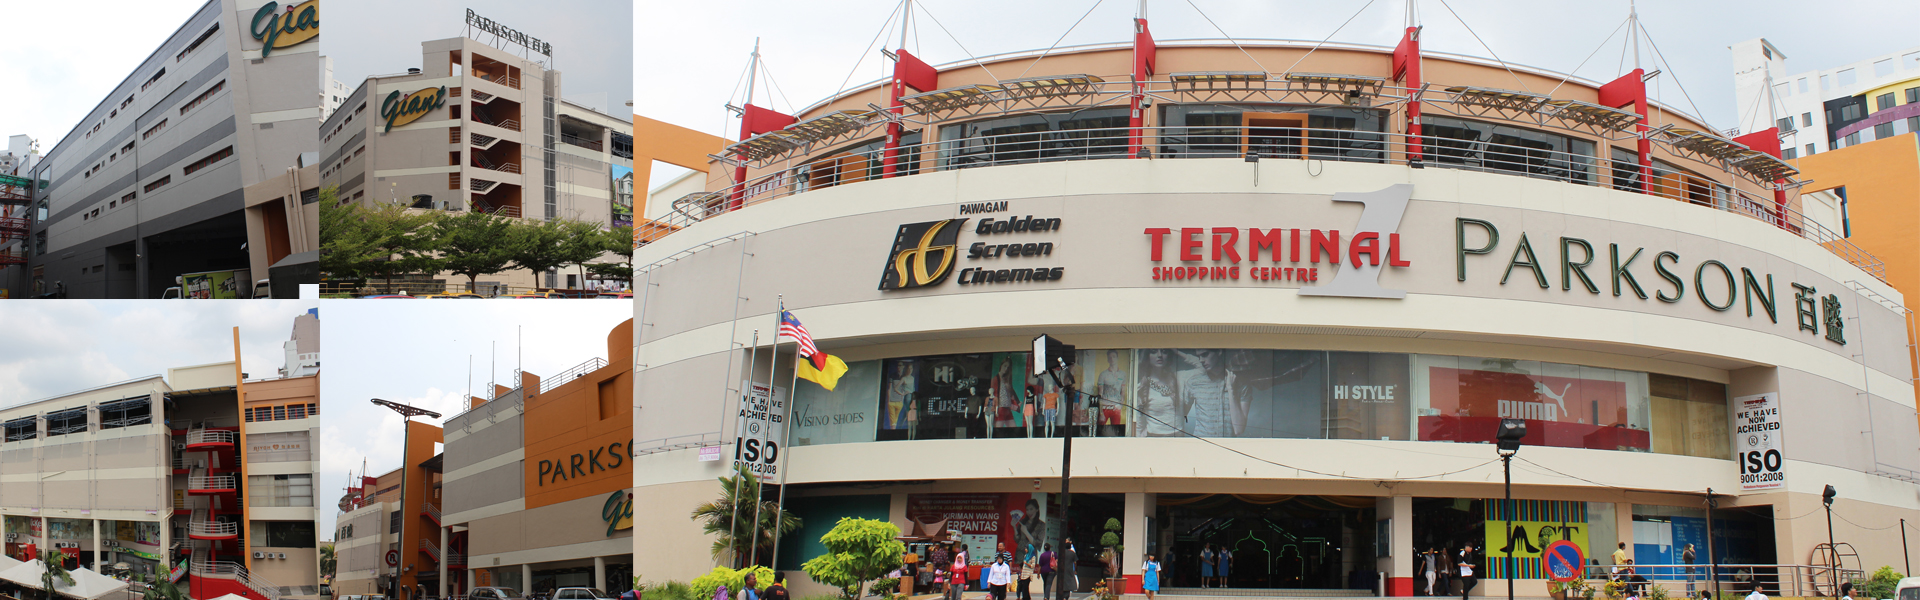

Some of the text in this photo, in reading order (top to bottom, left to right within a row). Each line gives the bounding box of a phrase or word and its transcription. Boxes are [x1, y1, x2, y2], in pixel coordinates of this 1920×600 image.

[465, 8, 528, 47] PARKSON
[381, 85, 446, 133] Giant
[960, 201, 1009, 215] PAWAGAM
[975, 215, 1062, 235] Golden
[967, 241, 1054, 259] Screen
[1144, 226, 1411, 269] TERMINAL
[957, 267, 1065, 285] Cinemas
[1152, 266, 1318, 282] SHOPPING CENTRE
[1455, 217, 1846, 345] PARKSON 百盛
[1334, 385, 1394, 400] HI STYLE
[759, 397, 782, 408] HVE
[1497, 399, 1557, 422] PUMA
[832, 412, 864, 425] SHOES
[1737, 407, 1777, 420] WE HAVE
[1748, 416, 1766, 425] NOW
[1737, 422, 1780, 434] ACHIEVED
[734, 437, 778, 464] ISO
[538, 438, 633, 486] PARKS
[733, 460, 777, 475] 901:2008
[1739, 449, 1782, 474] ISO
[1740, 472, 1783, 483] 9001:2008
[943, 512, 1000, 520] KIRIMAN WANG
